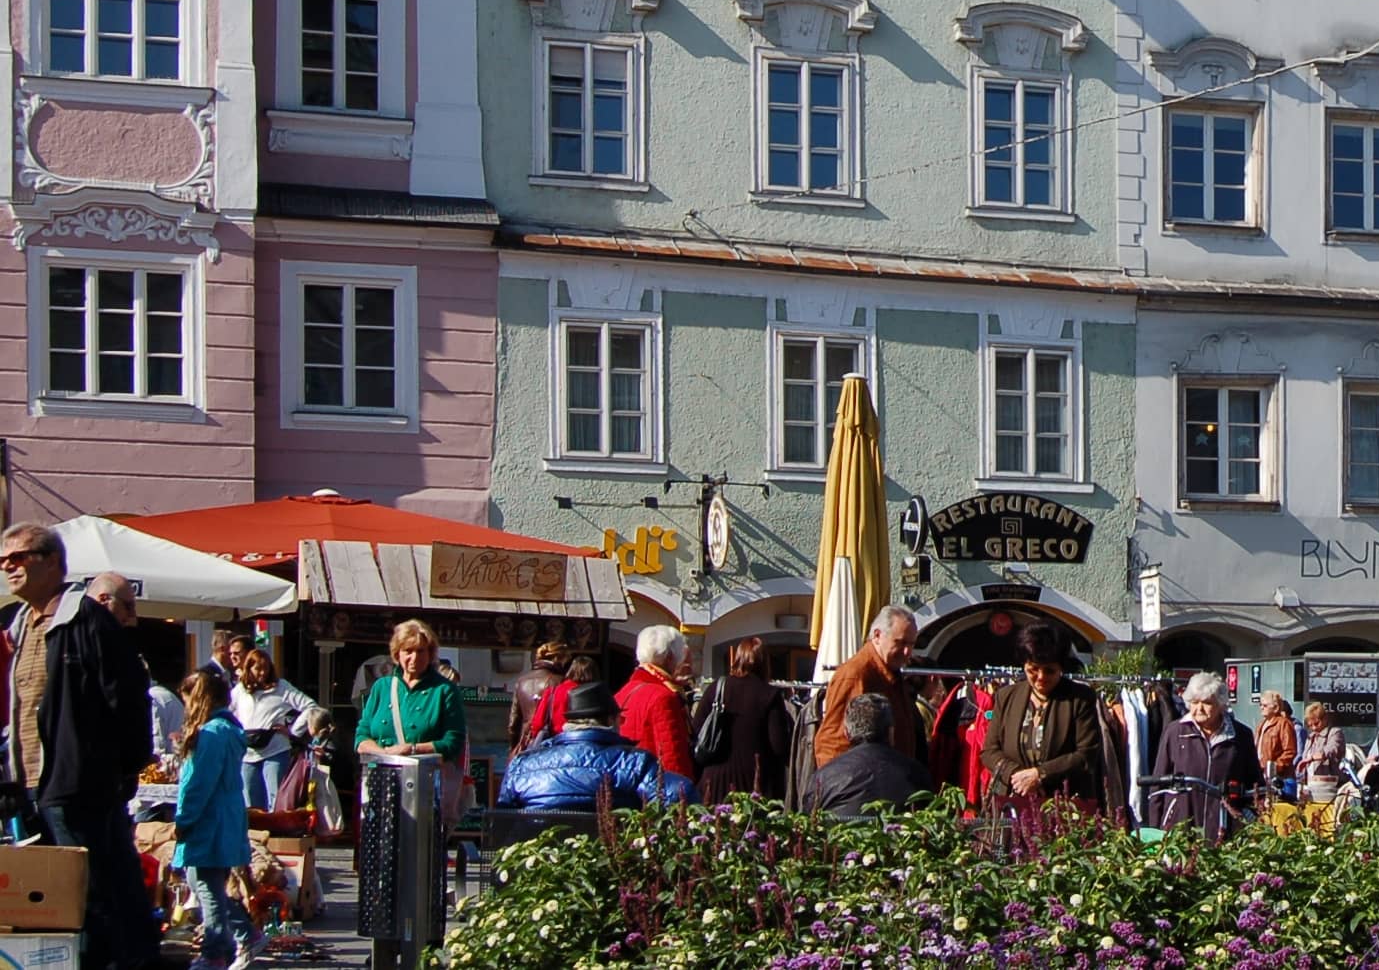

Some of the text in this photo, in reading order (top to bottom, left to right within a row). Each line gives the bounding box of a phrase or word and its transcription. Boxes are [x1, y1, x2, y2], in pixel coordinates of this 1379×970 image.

[932, 495, 1089, 533] RESTAURANT
[943, 537, 1079, 559] EL GRECO
[1323, 702, 1374, 714] EL GRECO
